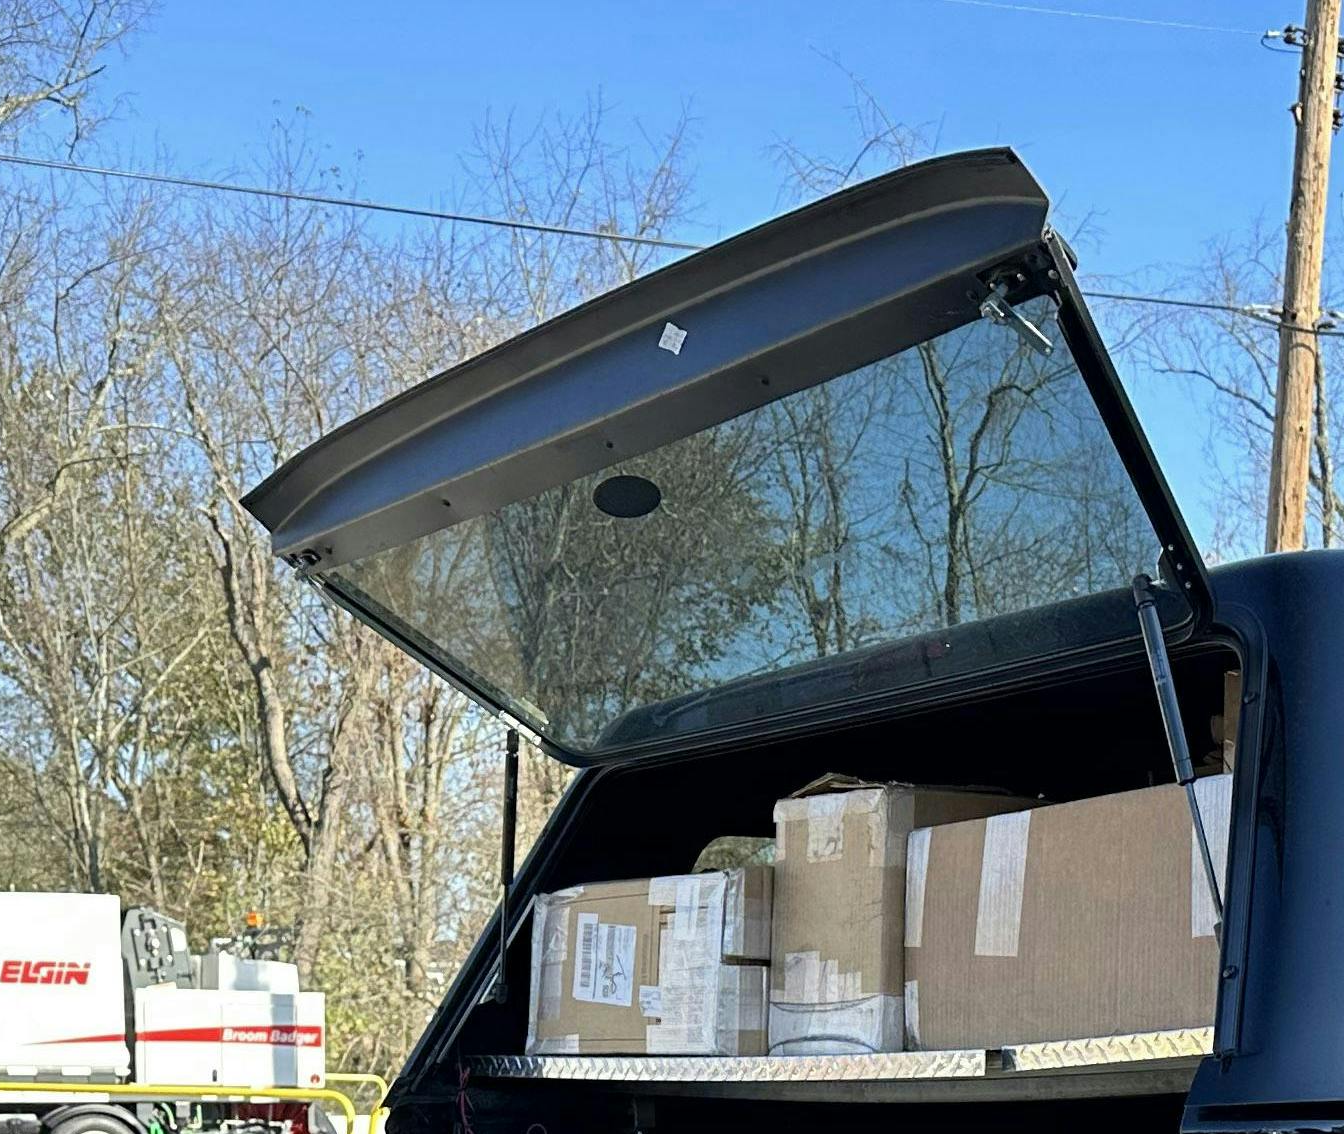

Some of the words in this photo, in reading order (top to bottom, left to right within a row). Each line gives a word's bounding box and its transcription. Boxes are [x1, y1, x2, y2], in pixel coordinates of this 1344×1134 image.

[0, 960, 91, 985] ELGIN
[223, 1028, 268, 1042] Broom
[270, 1029, 320, 1046] Badger
